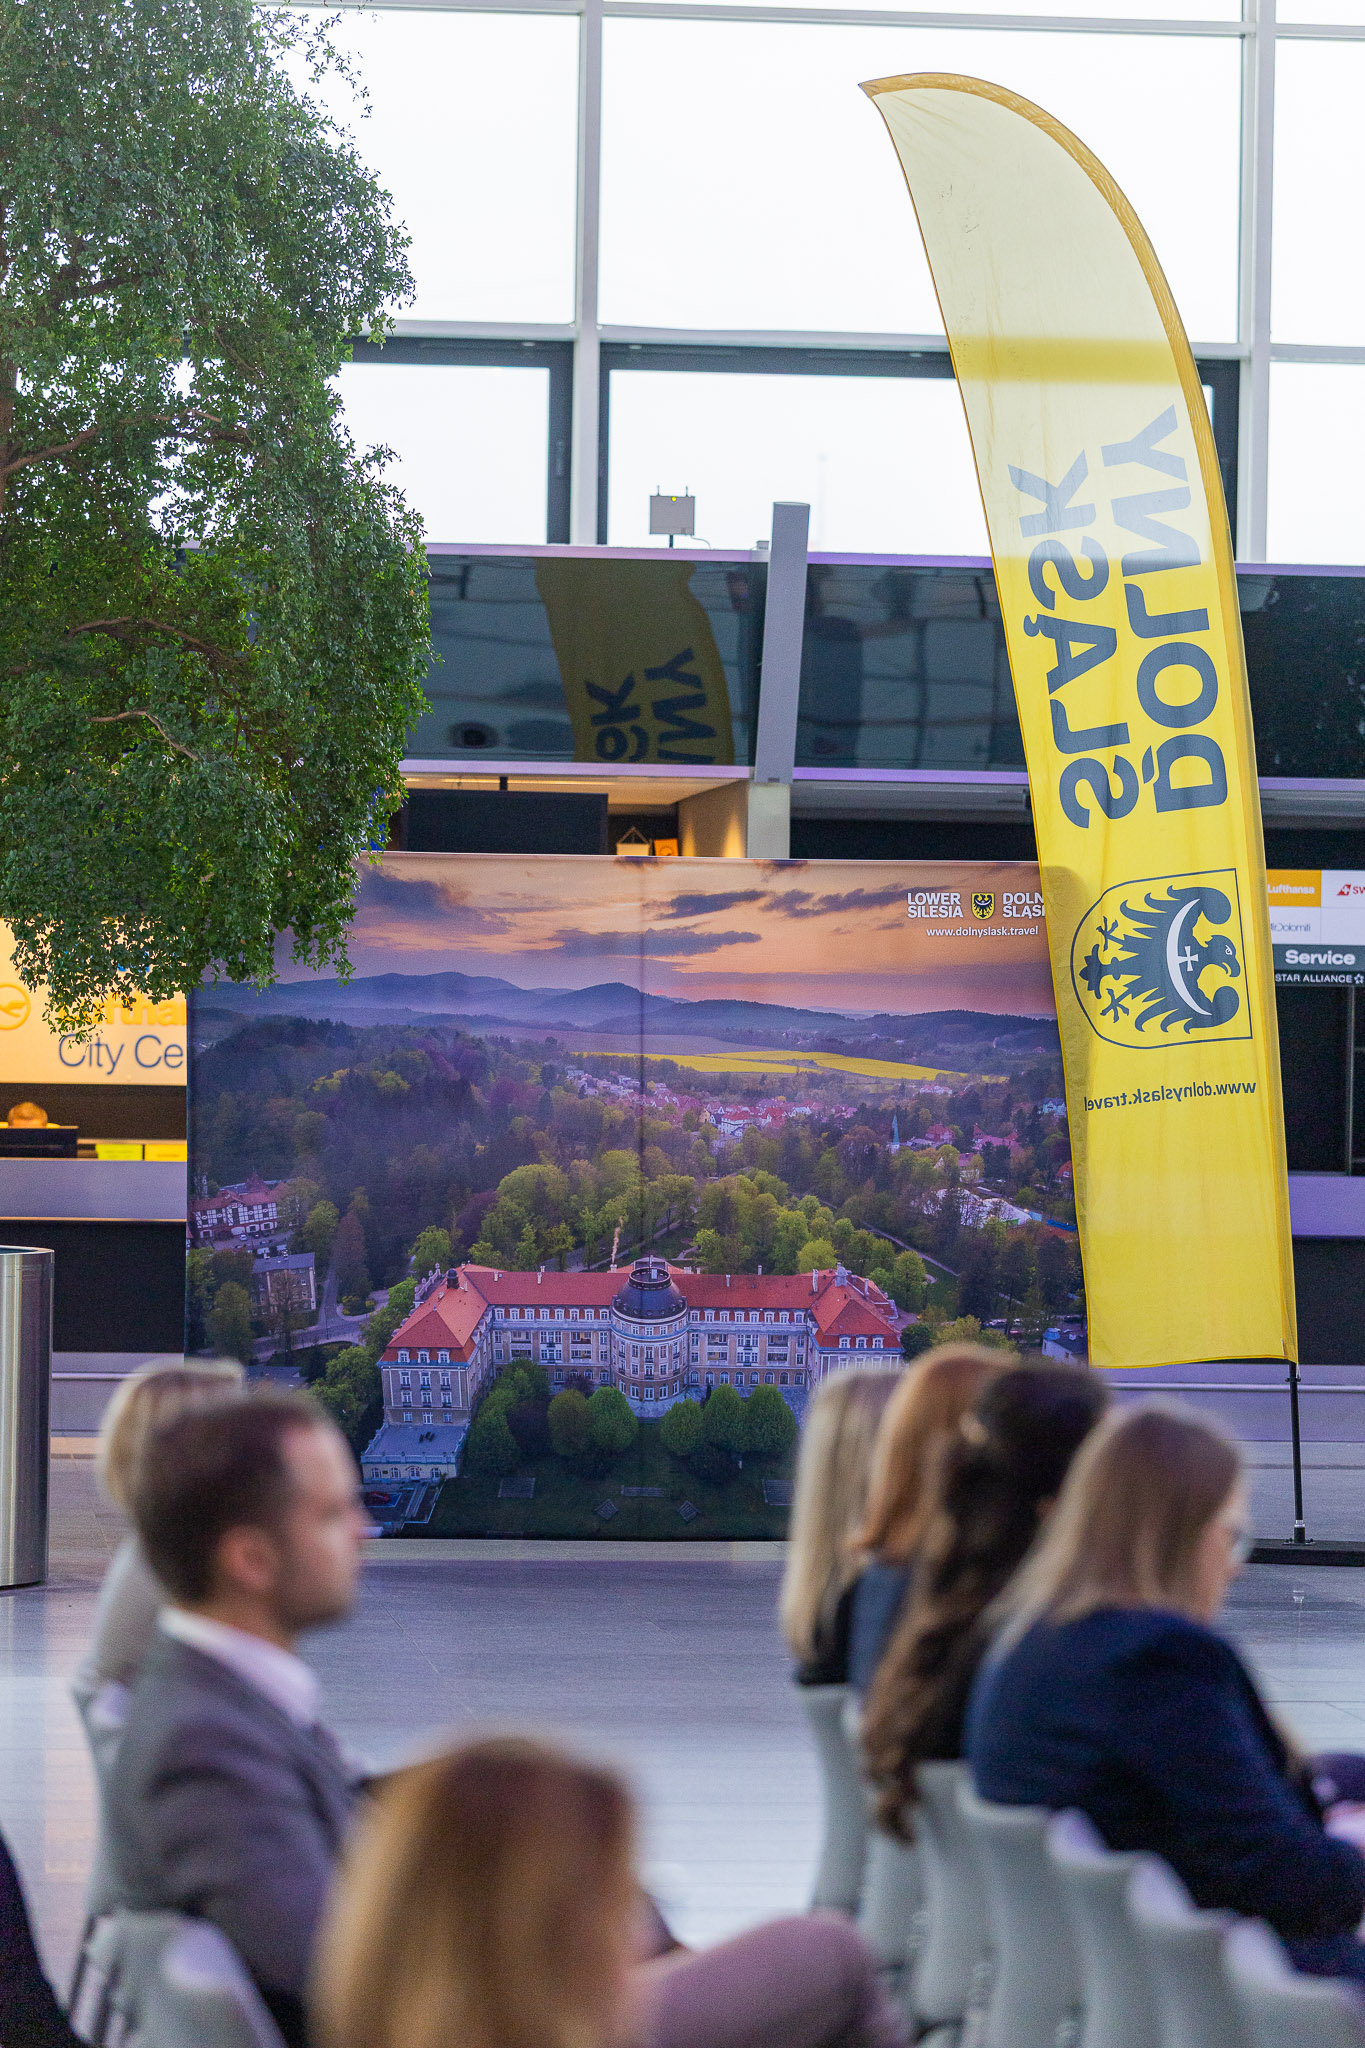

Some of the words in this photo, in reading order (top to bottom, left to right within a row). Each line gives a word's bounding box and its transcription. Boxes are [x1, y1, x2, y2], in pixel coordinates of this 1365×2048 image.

[907, 892, 961, 905] LOWER
[907, 905, 964, 918] SILESIA
[926, 926, 1039, 938] www.dolnyslask.travel
[1285, 949, 1356, 965] Service
[1275, 973, 1300, 982] STAR
[1303, 974, 1352, 983] ALLIANCE
[58, 1033, 124, 1075] City
[134, 1035, 183, 1069] Ce
